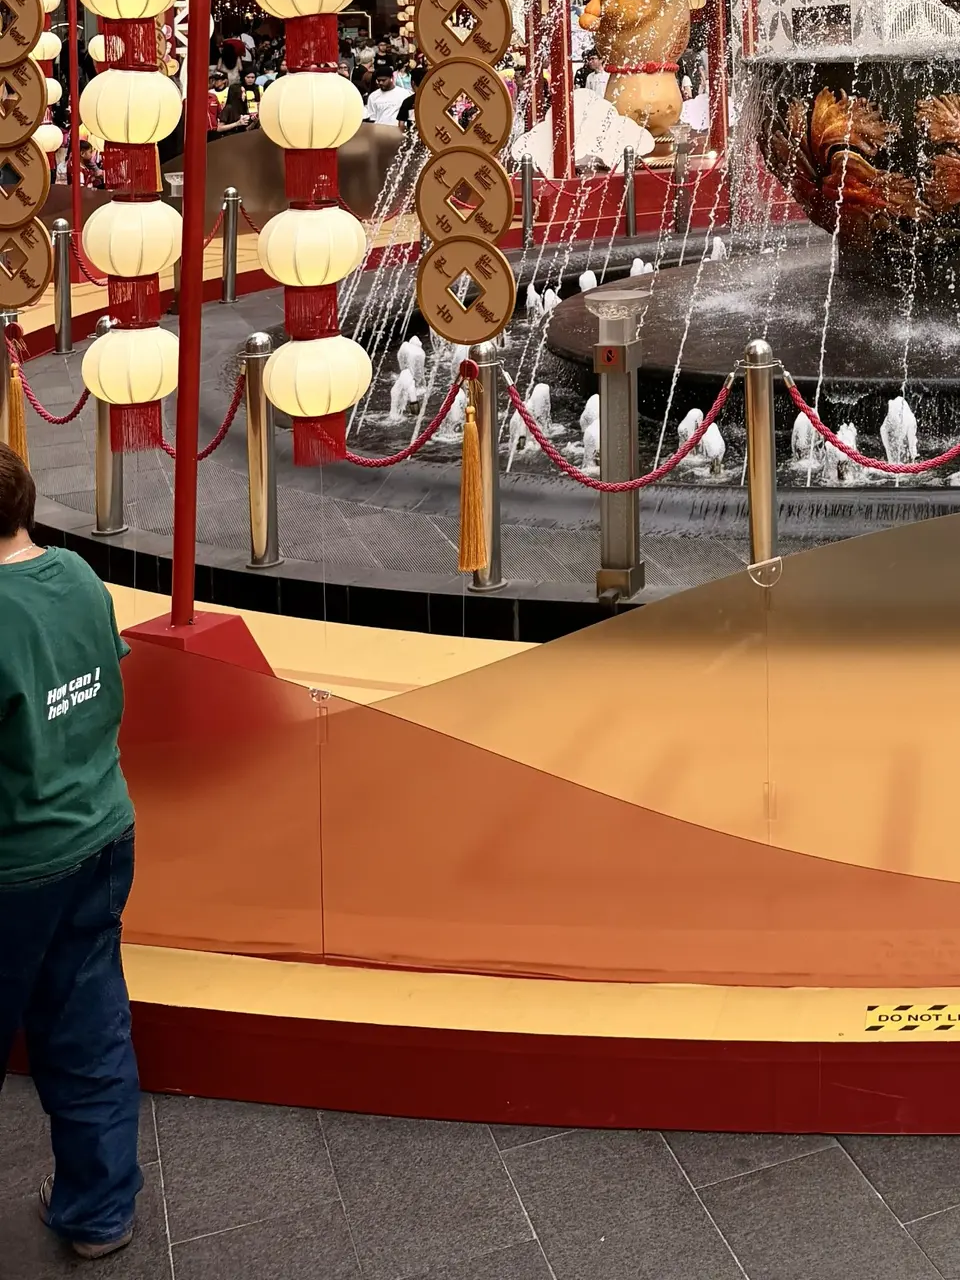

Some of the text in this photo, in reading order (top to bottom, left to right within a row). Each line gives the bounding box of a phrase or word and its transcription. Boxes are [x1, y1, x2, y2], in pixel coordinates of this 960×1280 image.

[47, 667, 100, 705] How can I
[48, 682, 101, 720] help You?
[878, 1014, 902, 1022] DO
[908, 1013, 942, 1022] NOT
